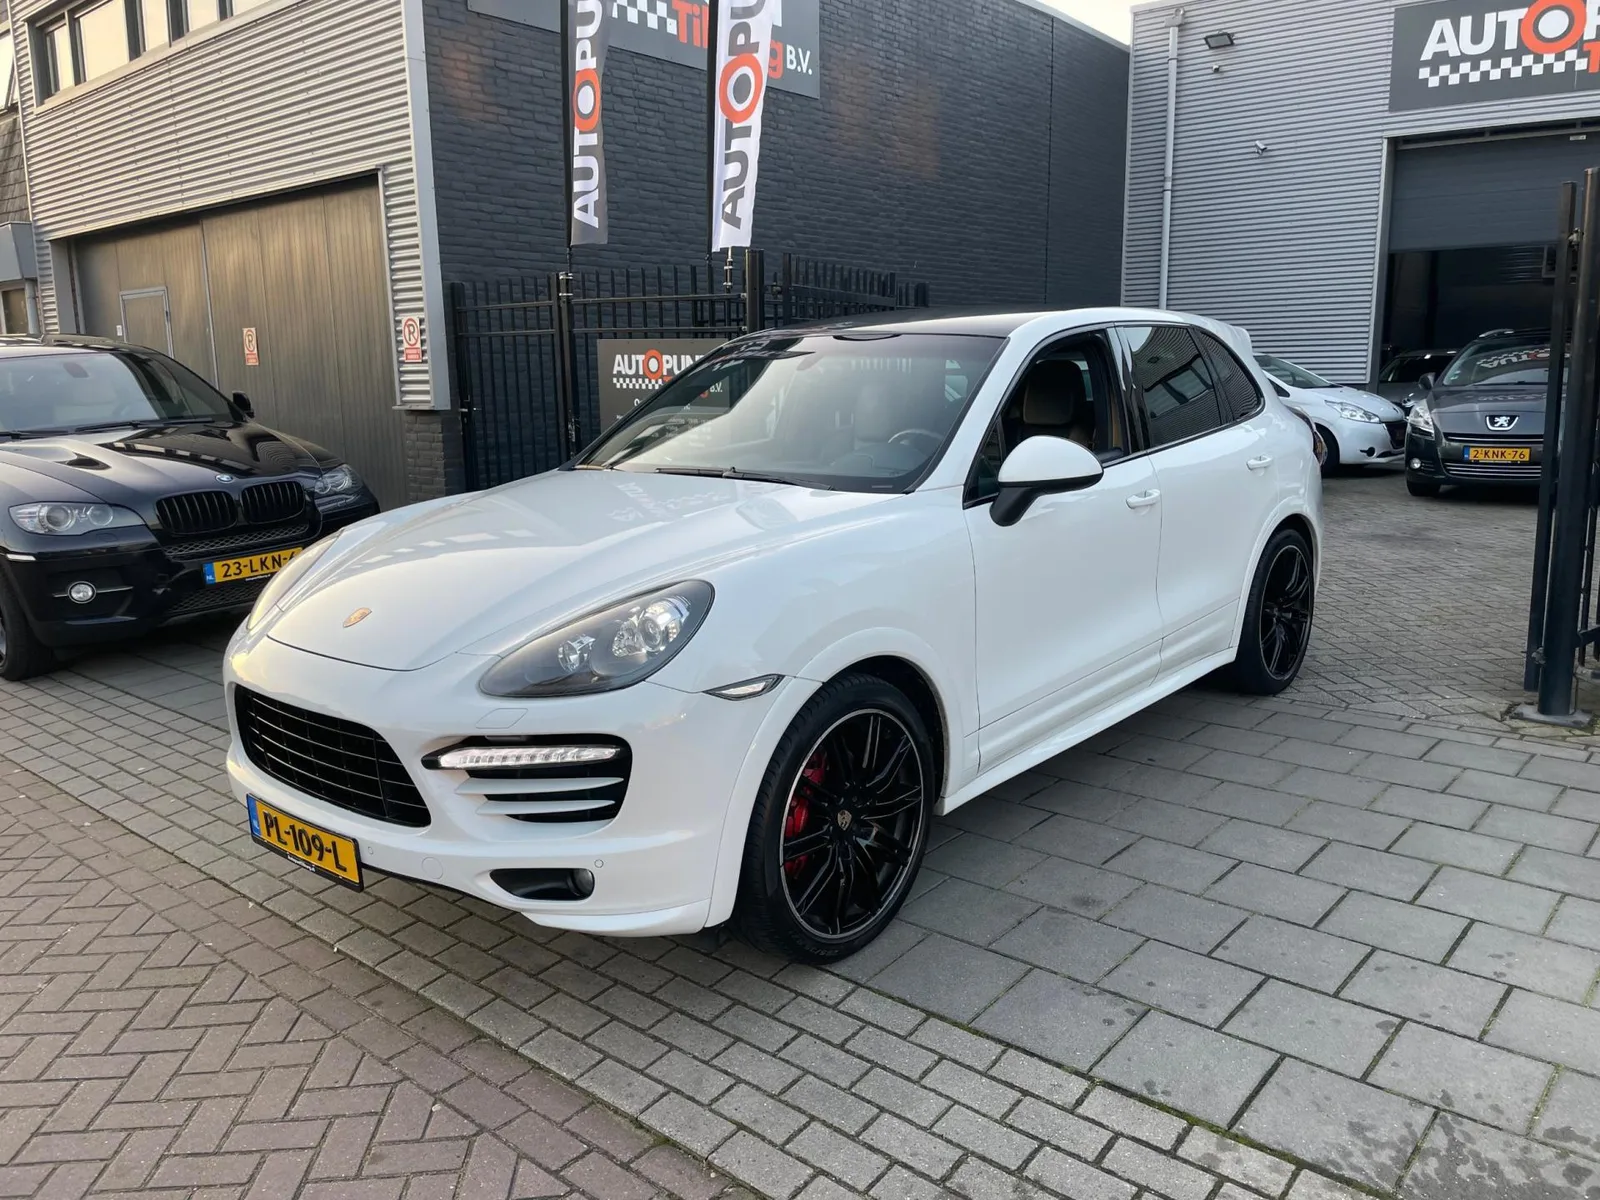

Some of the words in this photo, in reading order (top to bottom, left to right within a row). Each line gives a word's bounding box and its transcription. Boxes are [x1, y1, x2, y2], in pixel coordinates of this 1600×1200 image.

[786, 44, 813, 75] B.V.
[613, 349, 705, 381] AUTOPUN
[1473, 449, 1526, 460] 2-KNK-76
[263, 810, 347, 872] PL-109-L
